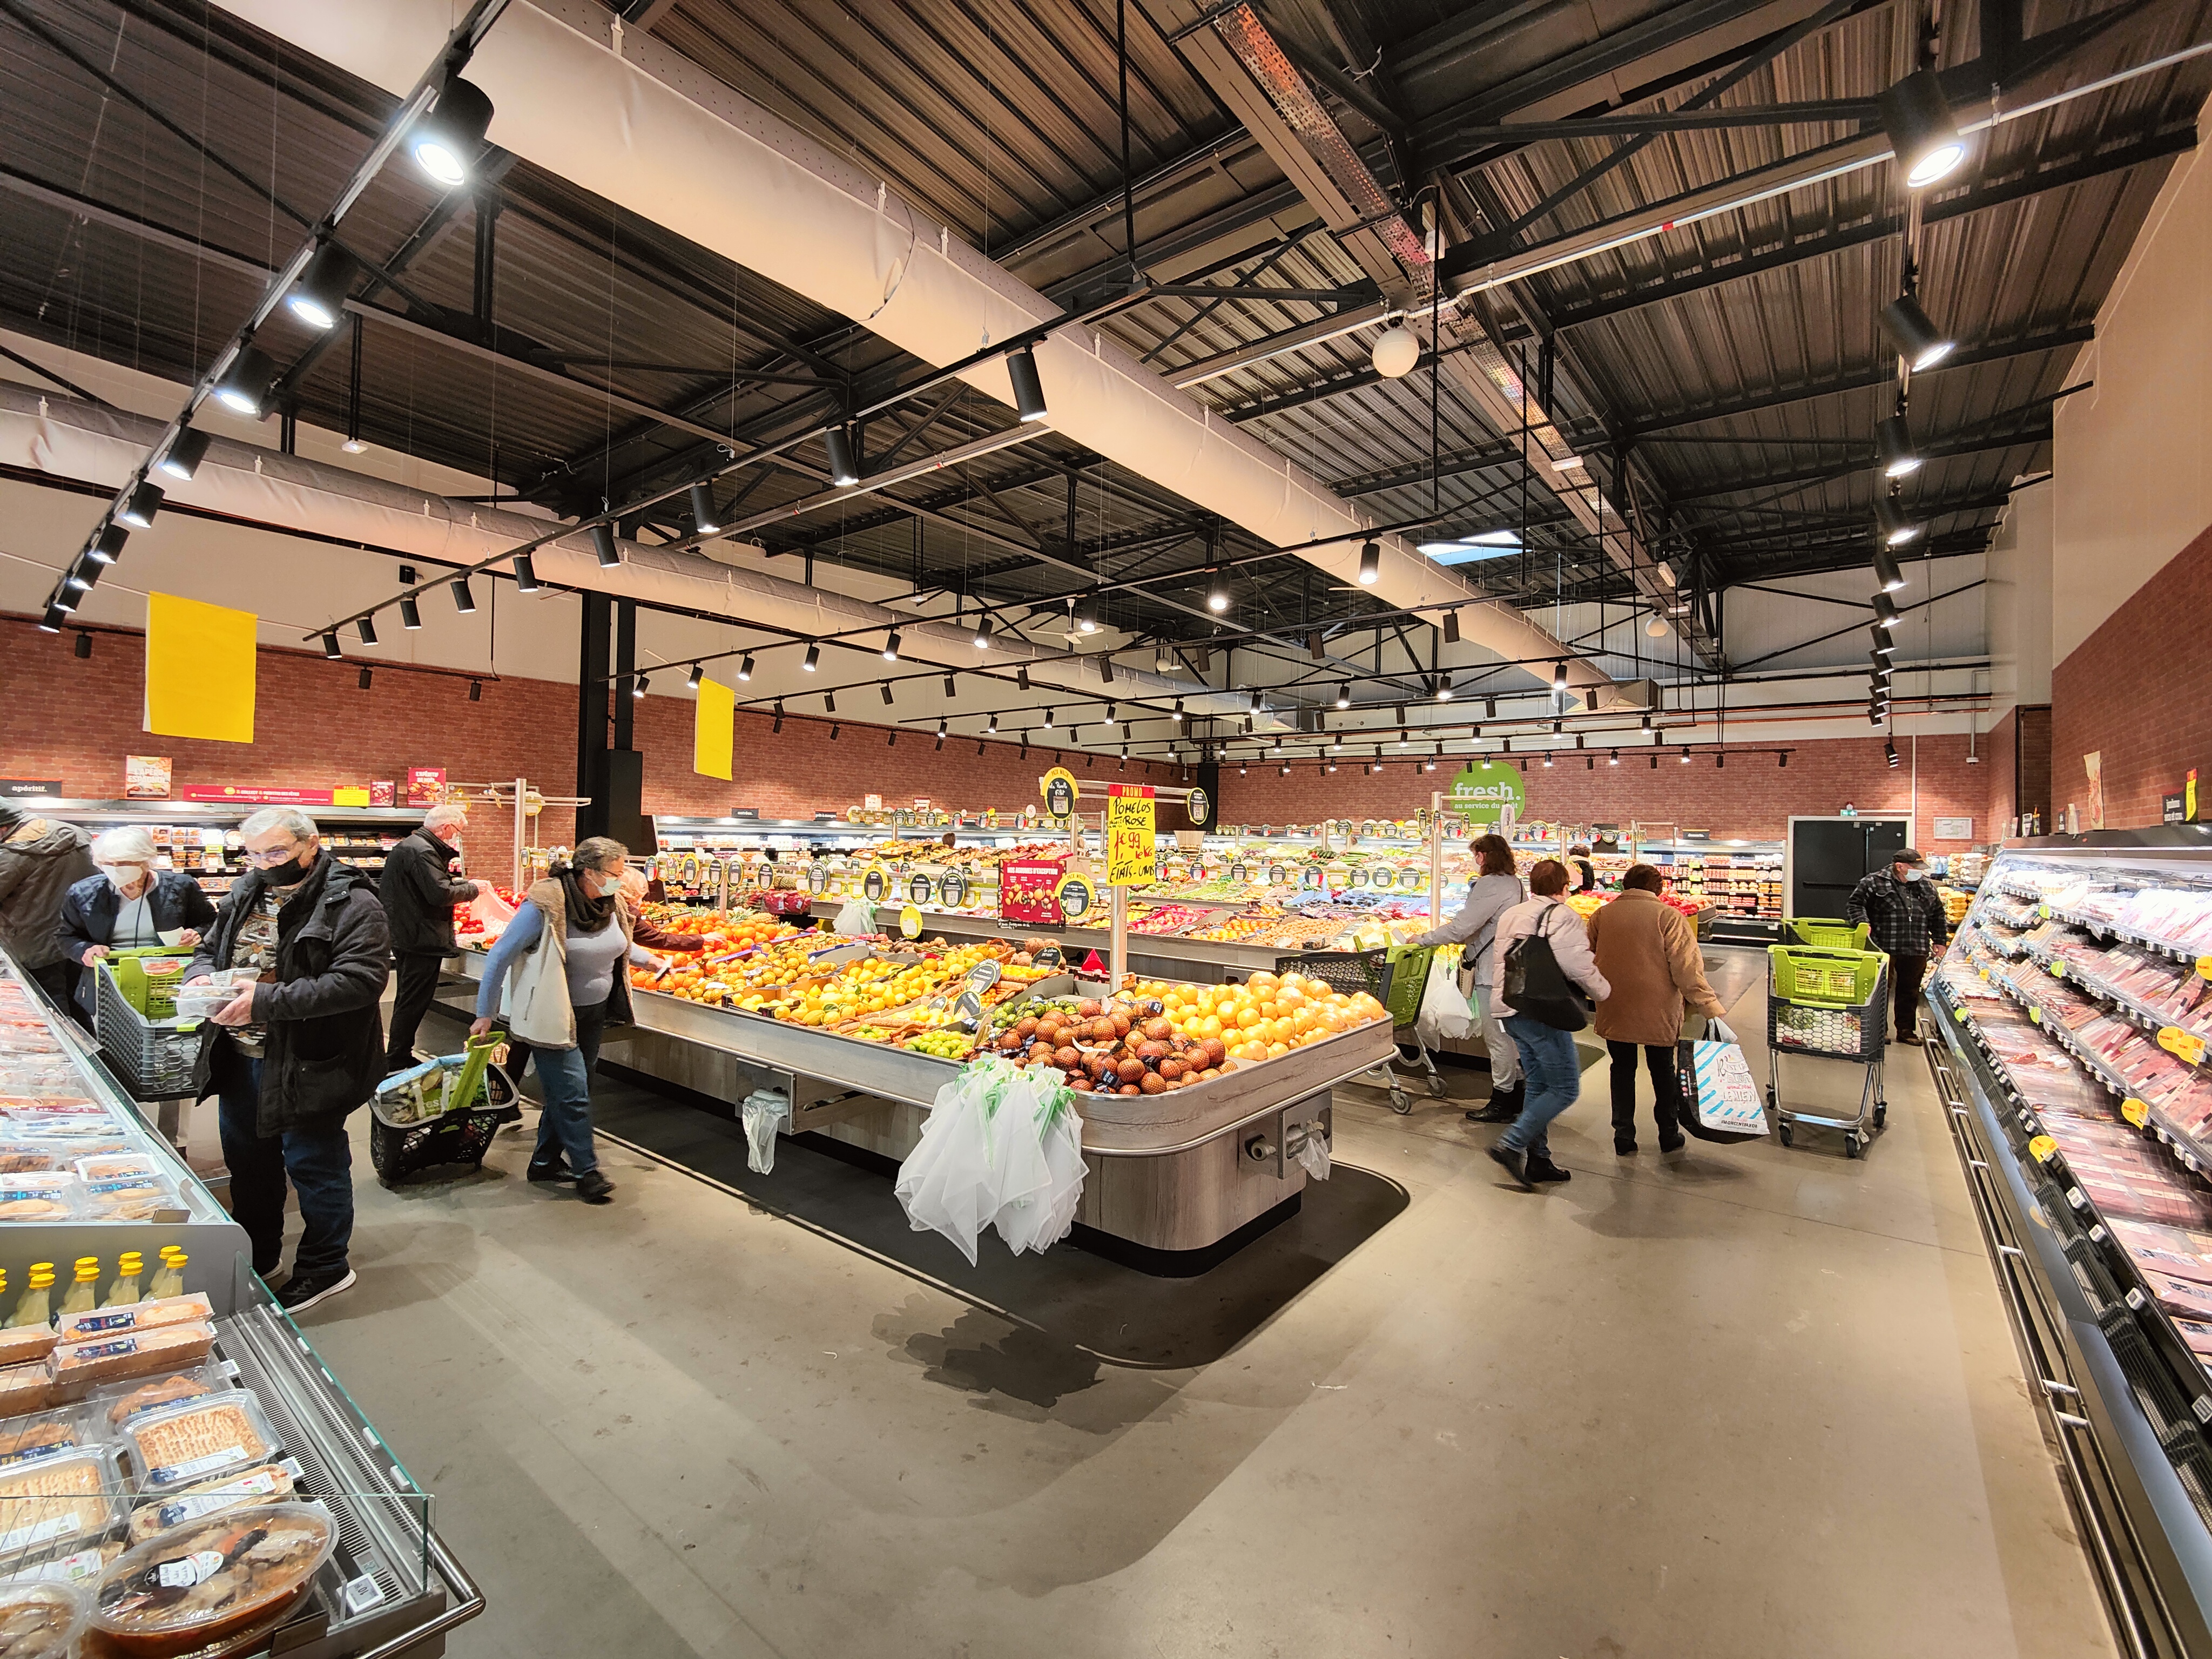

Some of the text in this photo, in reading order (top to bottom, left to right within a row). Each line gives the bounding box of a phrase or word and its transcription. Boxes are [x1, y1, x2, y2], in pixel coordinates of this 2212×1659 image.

[127, 775, 169, 784] ESPAGNOL
[11, 784, 48, 793] apéritif.
[1122, 786, 1143, 797] PROMO
[1455, 782, 1521, 800] fresh.
[1123, 815, 1147, 826] ROSE
[2033, 1139, 2044, 1148] PROMO
